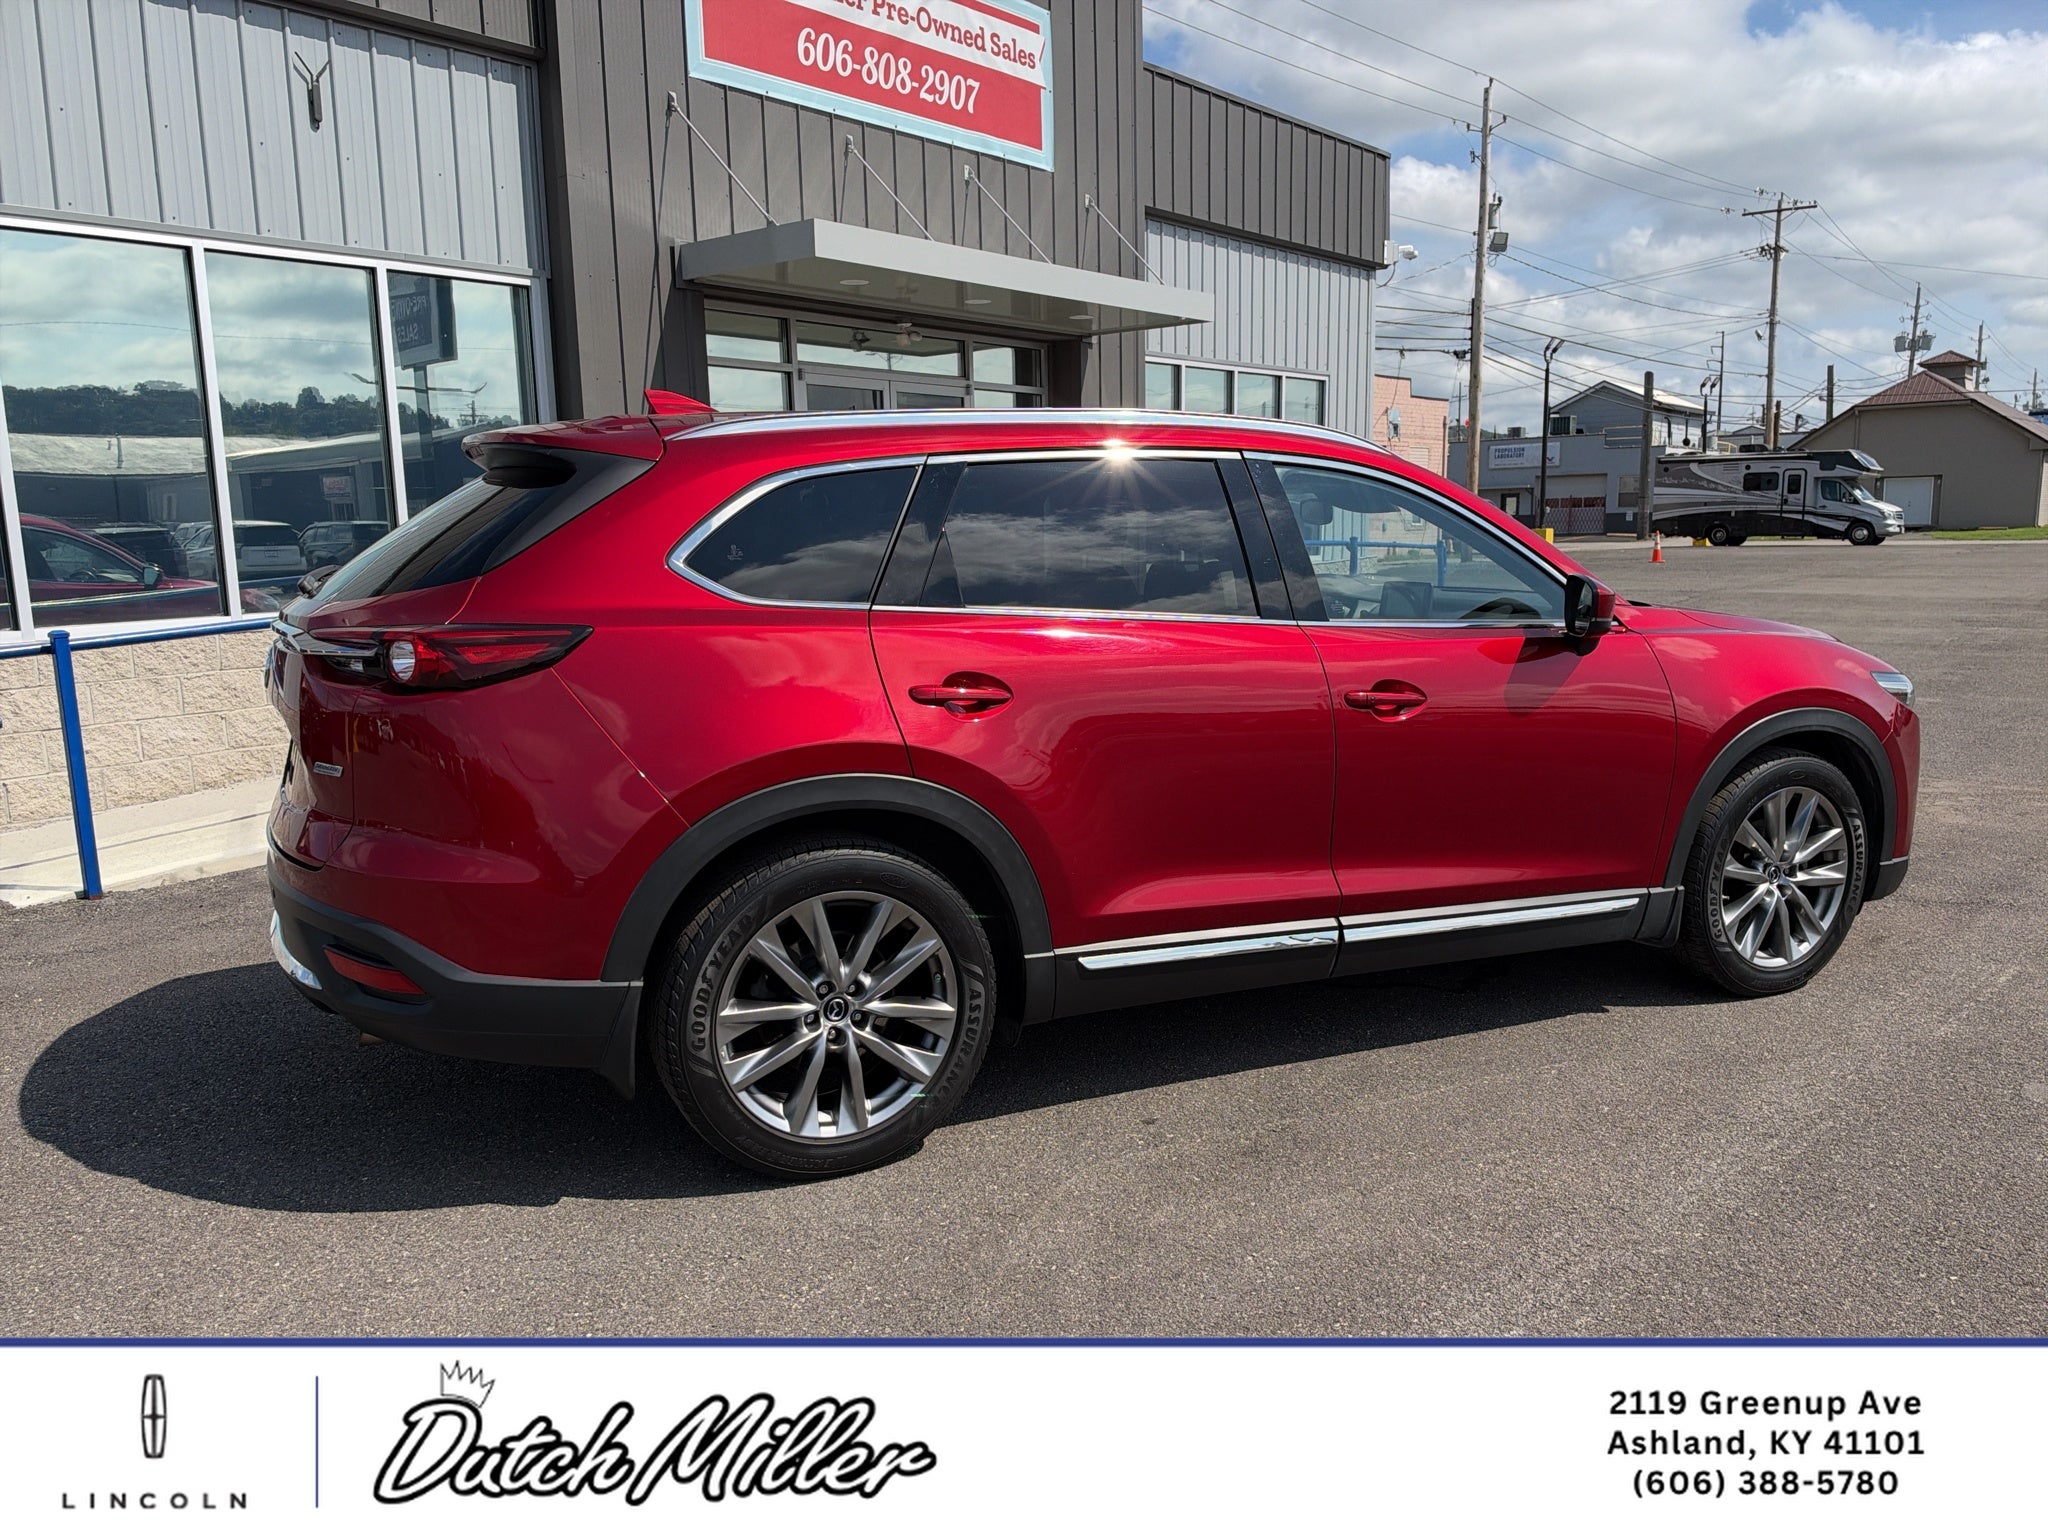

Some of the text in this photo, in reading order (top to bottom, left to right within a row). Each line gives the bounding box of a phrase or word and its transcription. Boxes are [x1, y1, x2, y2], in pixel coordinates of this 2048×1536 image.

[797, 27, 980, 114] 606-808-2907
[872, 0, 987, 52] Pre-Owned
[990, 32, 1036, 69] Sales
